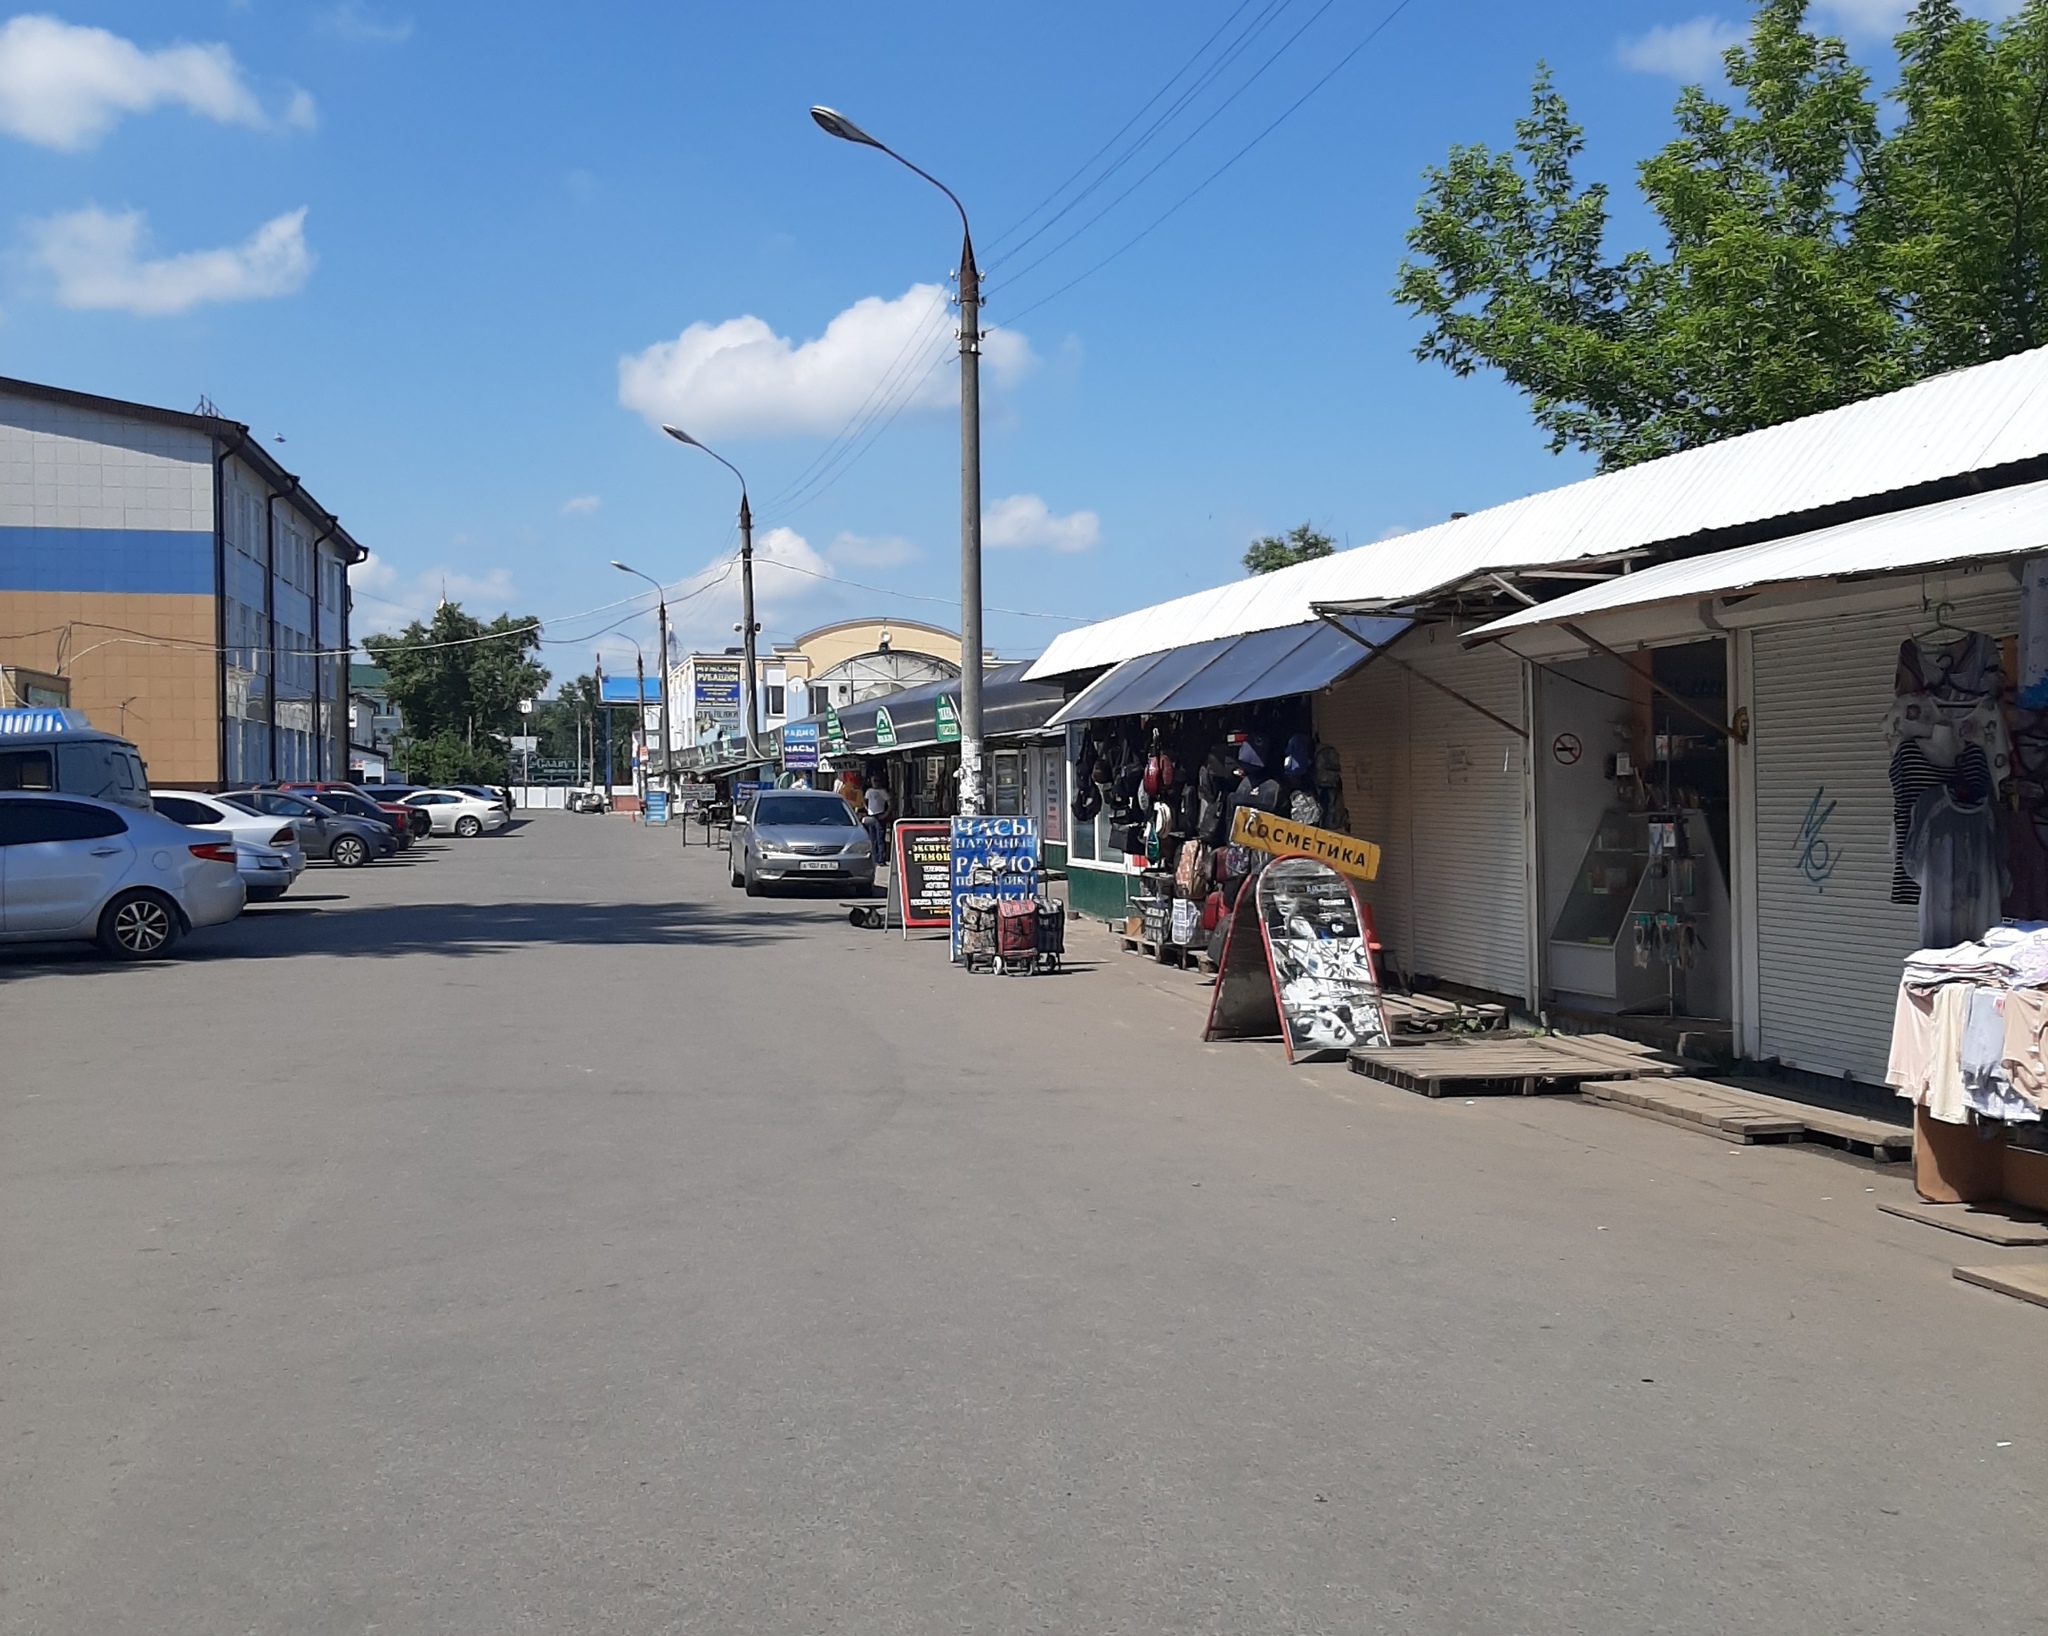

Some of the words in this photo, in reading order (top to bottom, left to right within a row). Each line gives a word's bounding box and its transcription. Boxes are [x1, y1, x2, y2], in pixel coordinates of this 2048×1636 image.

[697, 673, 738, 682] РУБАШКИ
[784, 729, 815, 738] РАДИО
[784, 745, 815, 753] ЧАСЫ
[956, 818, 1034, 836] ЧАСЫ
[955, 837, 1035, 850] НАРУЧНЫЕ
[1242, 820, 1366, 868] КОСМЕТИКА
